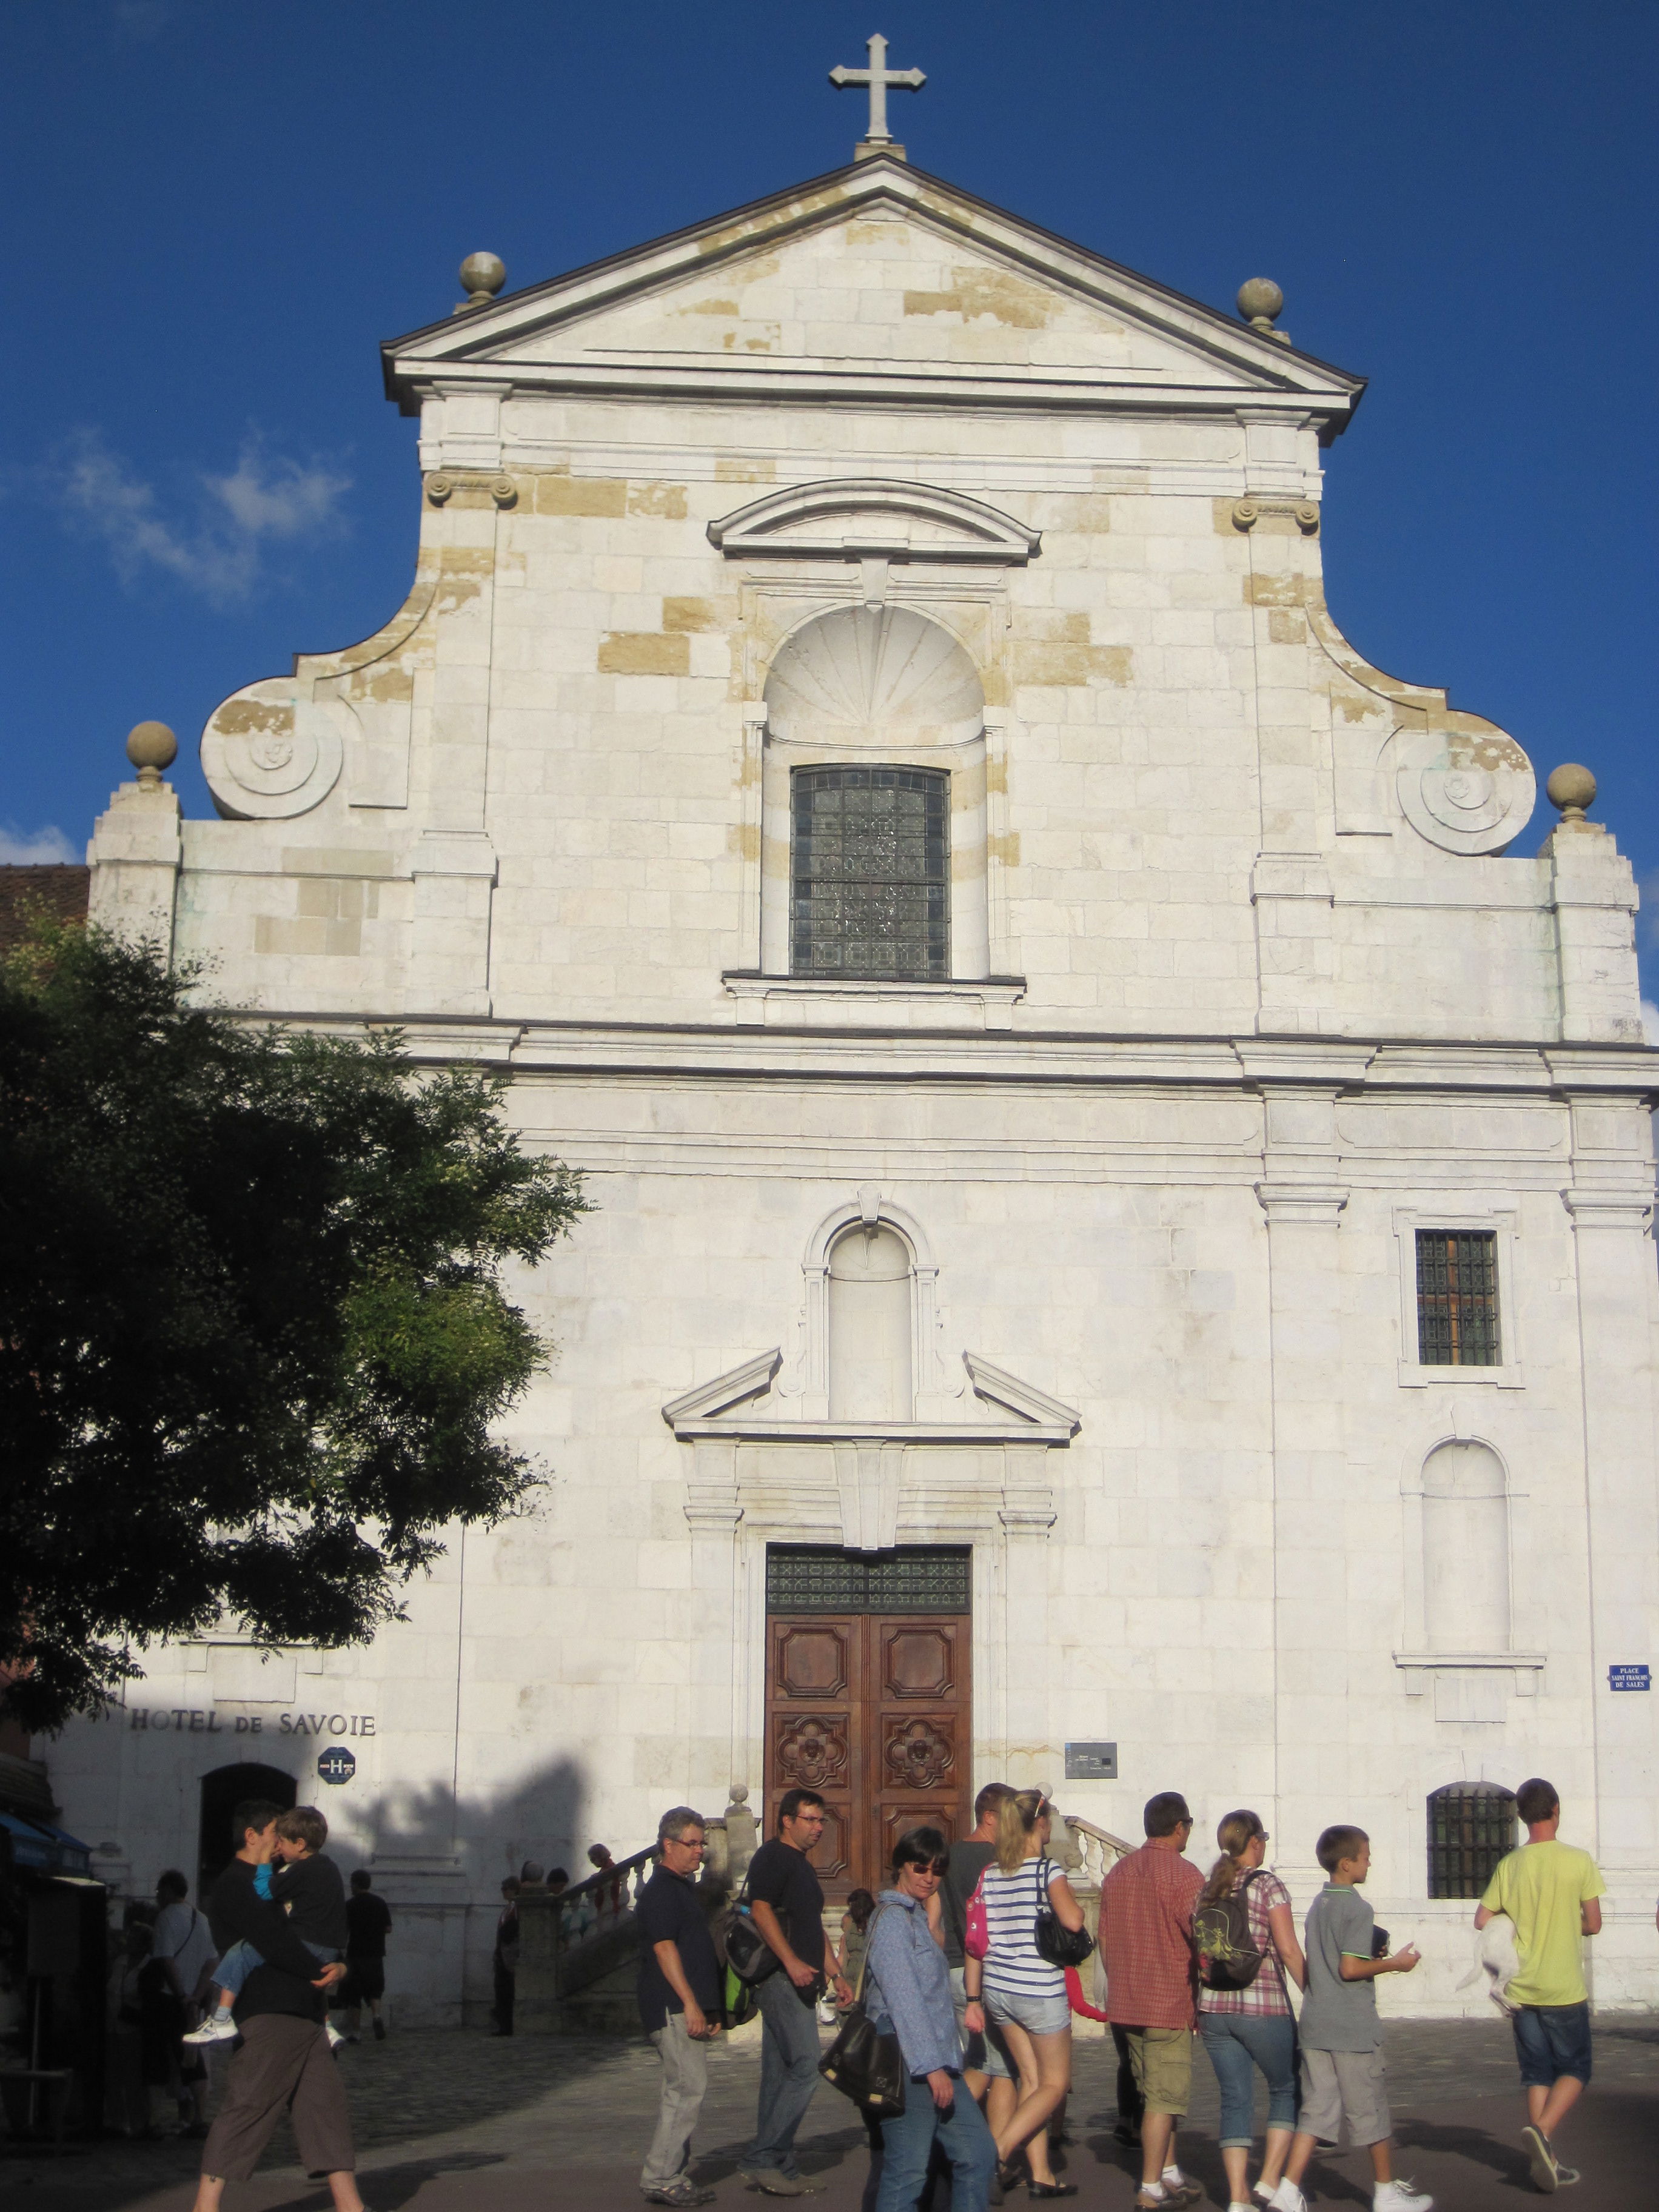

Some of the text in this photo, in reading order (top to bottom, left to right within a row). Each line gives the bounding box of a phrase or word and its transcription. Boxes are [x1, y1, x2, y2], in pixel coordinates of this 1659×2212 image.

[130, 1708, 377, 1737] HOTEL DE SAVOIE
[330, 1758, 343, 1774] H
